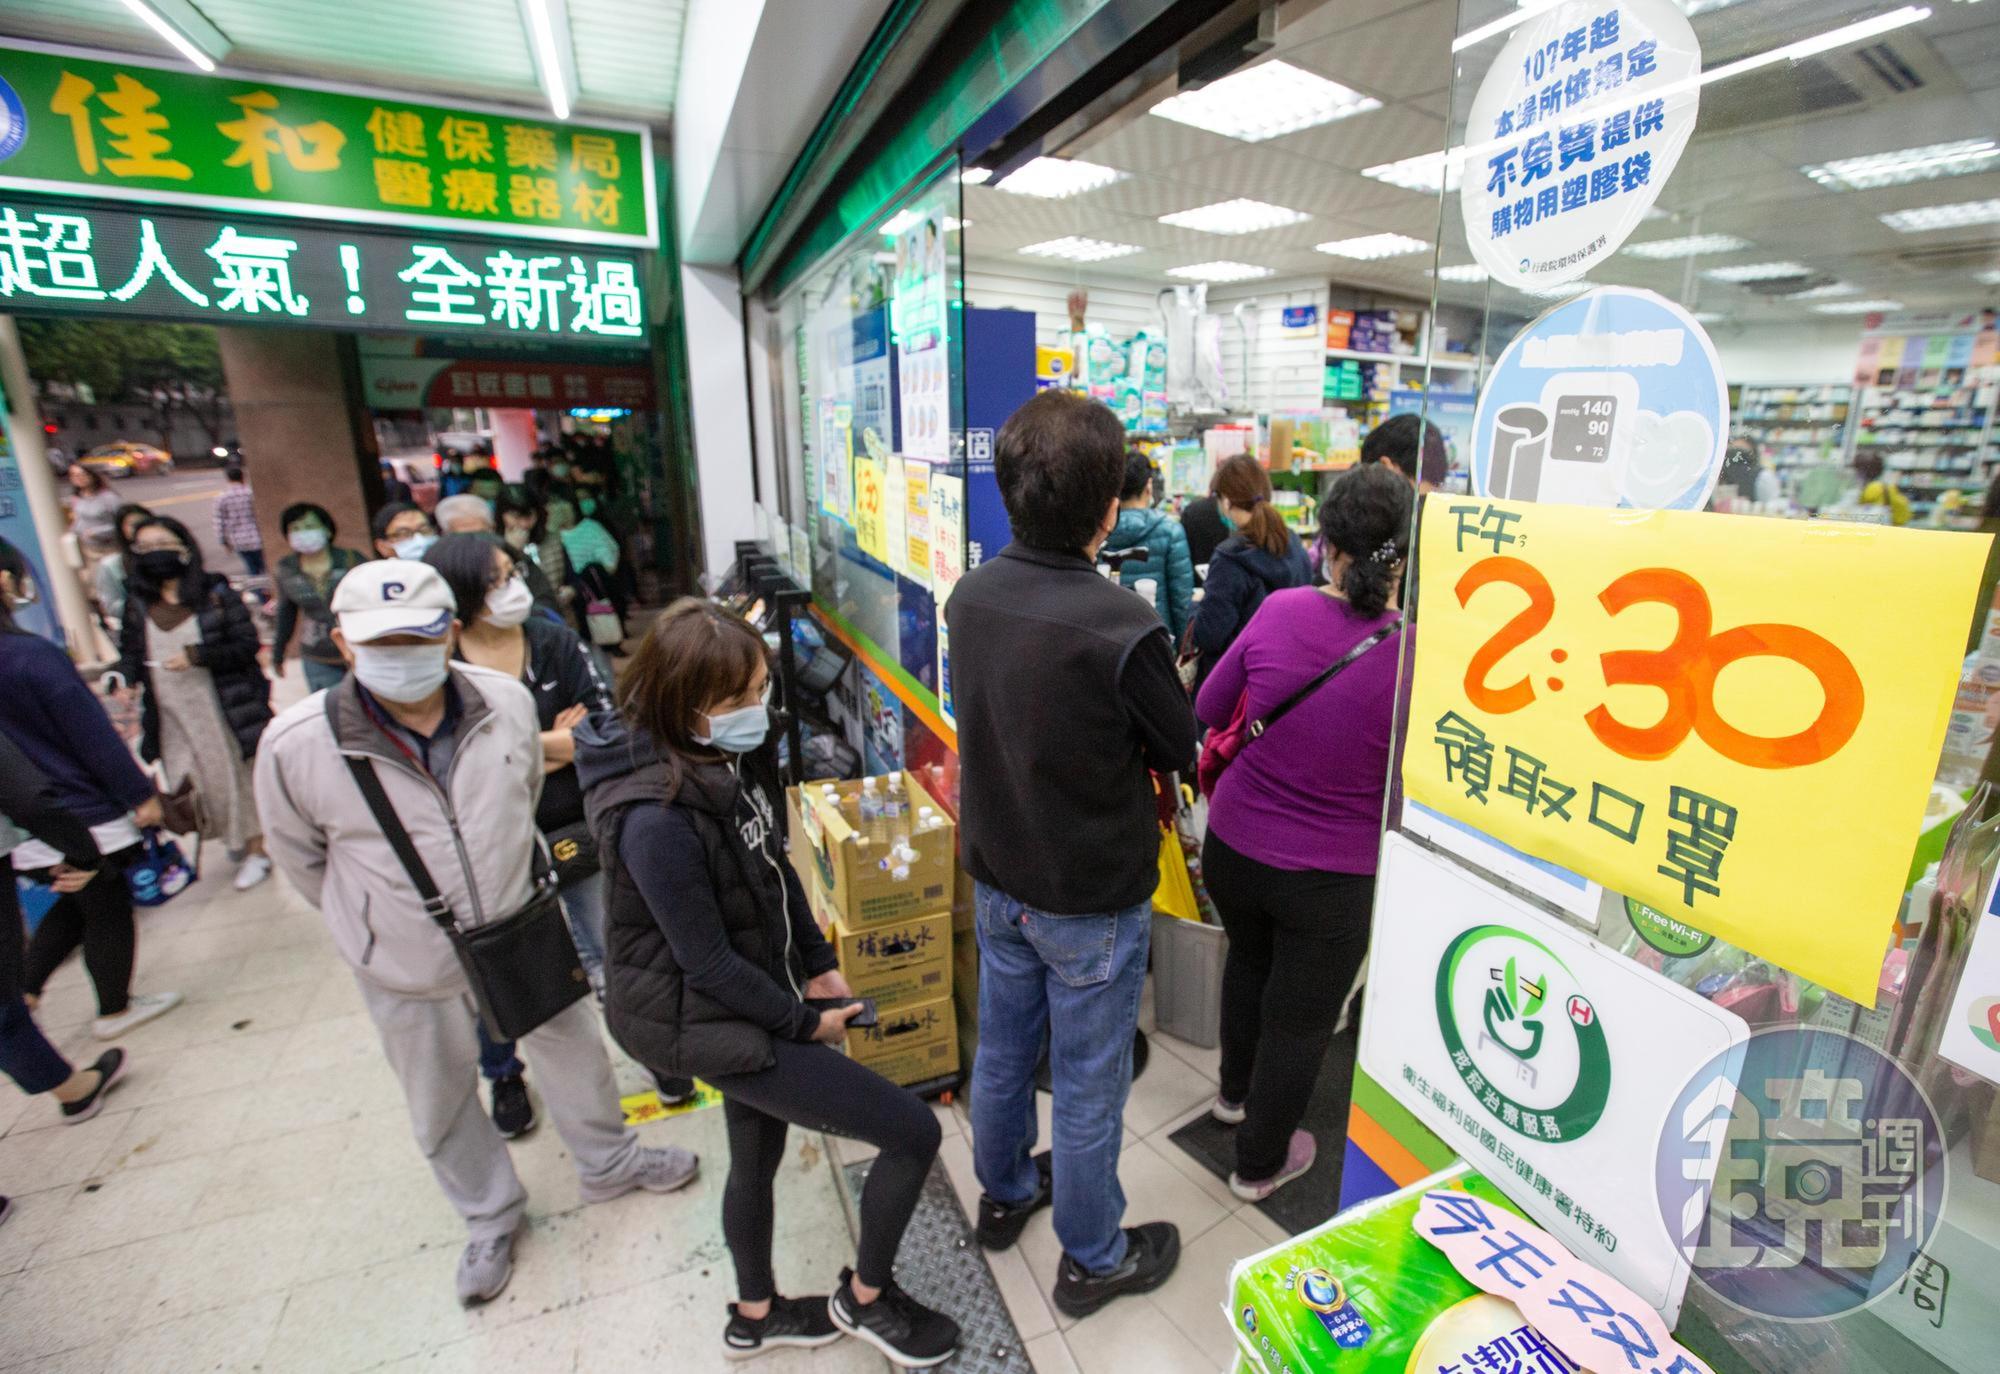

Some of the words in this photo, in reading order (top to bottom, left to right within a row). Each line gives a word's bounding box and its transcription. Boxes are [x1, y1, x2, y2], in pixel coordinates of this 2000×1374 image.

[1523, 9, 1620, 87] 107年起
[51, 71, 347, 192] 佳和
[366, 107, 621, 180] 健保藥局
[1487, 98, 1665, 198] 不免費提供
[373, 158, 623, 226] 醫療器材
[1491, 151, 1652, 240] 購物用塑膠袋
[1582, 400, 1612, 416] 140
[1588, 420, 1609, 435] 90
[1592, 447, 1604, 456] 72
[1449, 504, 1522, 554] 下午
[1454, 556, 1865, 769] 2:30
[1433, 710, 1739, 907] 領取口罩
[1670, 919, 1703, 945] Wi-Fi
[1452, 1048, 1562, 1139] 戒菸治療服務
[1401, 1063, 1618, 1253] 衛生福利部國民健康署特約
